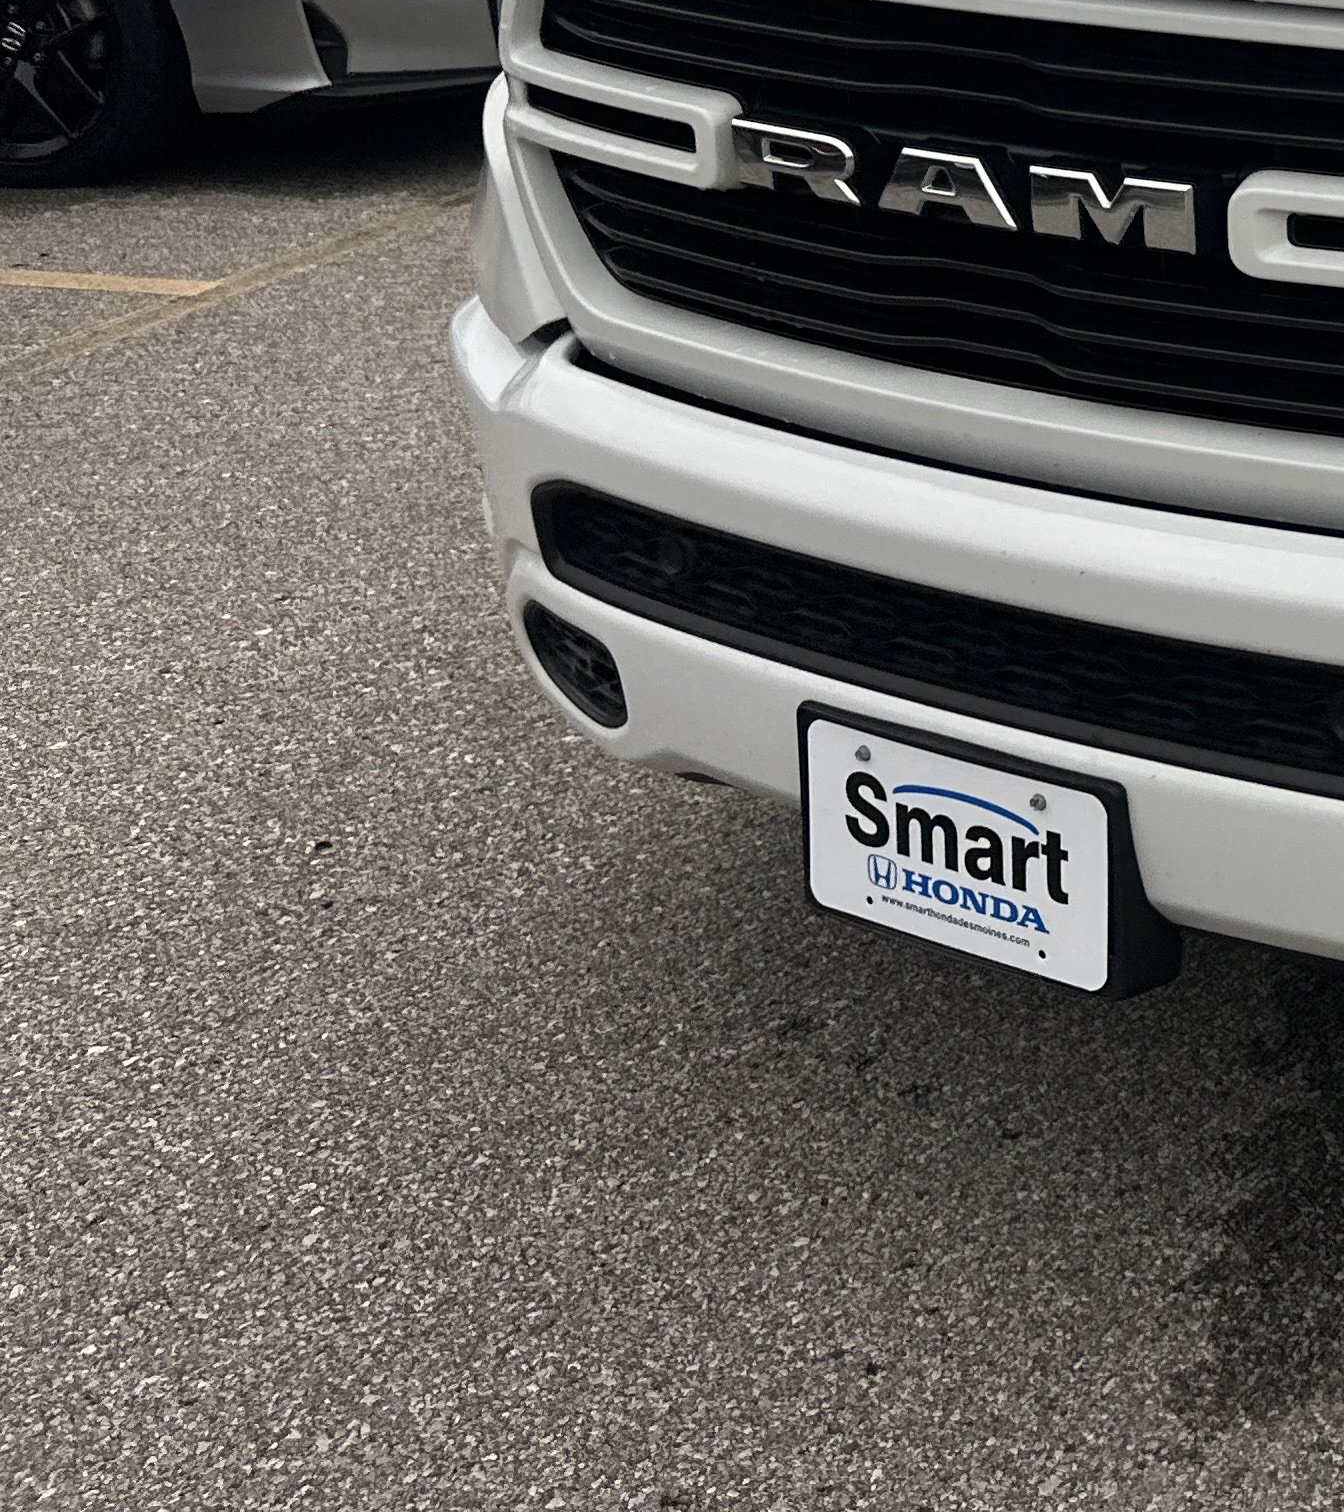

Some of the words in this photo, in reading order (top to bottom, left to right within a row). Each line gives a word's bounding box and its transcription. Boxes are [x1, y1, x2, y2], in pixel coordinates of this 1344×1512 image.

[731, 117, 1197, 255] RAM
[845, 771, 1069, 905] Smart
[881, 894, 1031, 947] www.smarthondadesmoines.com
[902, 868, 1050, 934] HONDA
